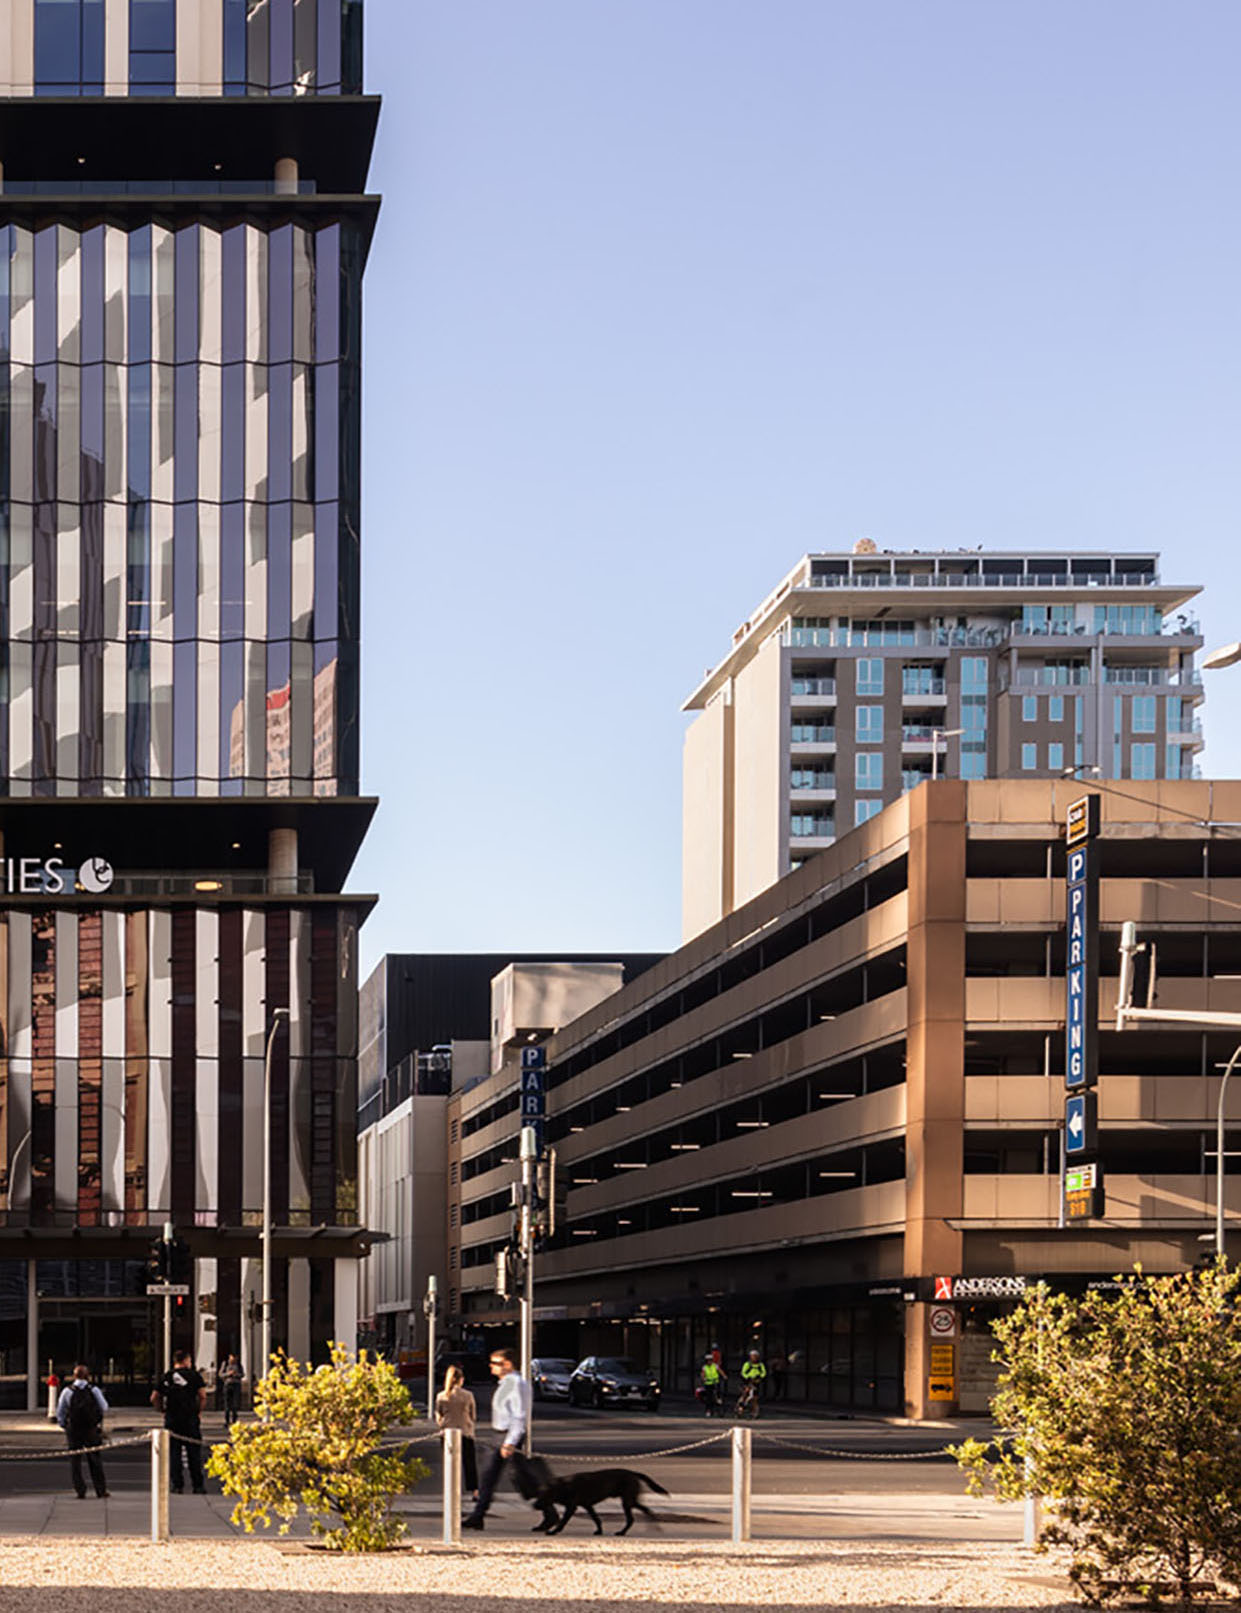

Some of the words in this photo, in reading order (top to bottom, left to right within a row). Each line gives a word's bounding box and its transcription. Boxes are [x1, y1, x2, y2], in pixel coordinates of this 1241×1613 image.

[1071, 853, 1083, 881] P
[1070, 889, 1082, 1077] PARKING
[526, 1049, 539, 1128] PAR
[954, 1277, 1026, 1291] ANDERSONS
